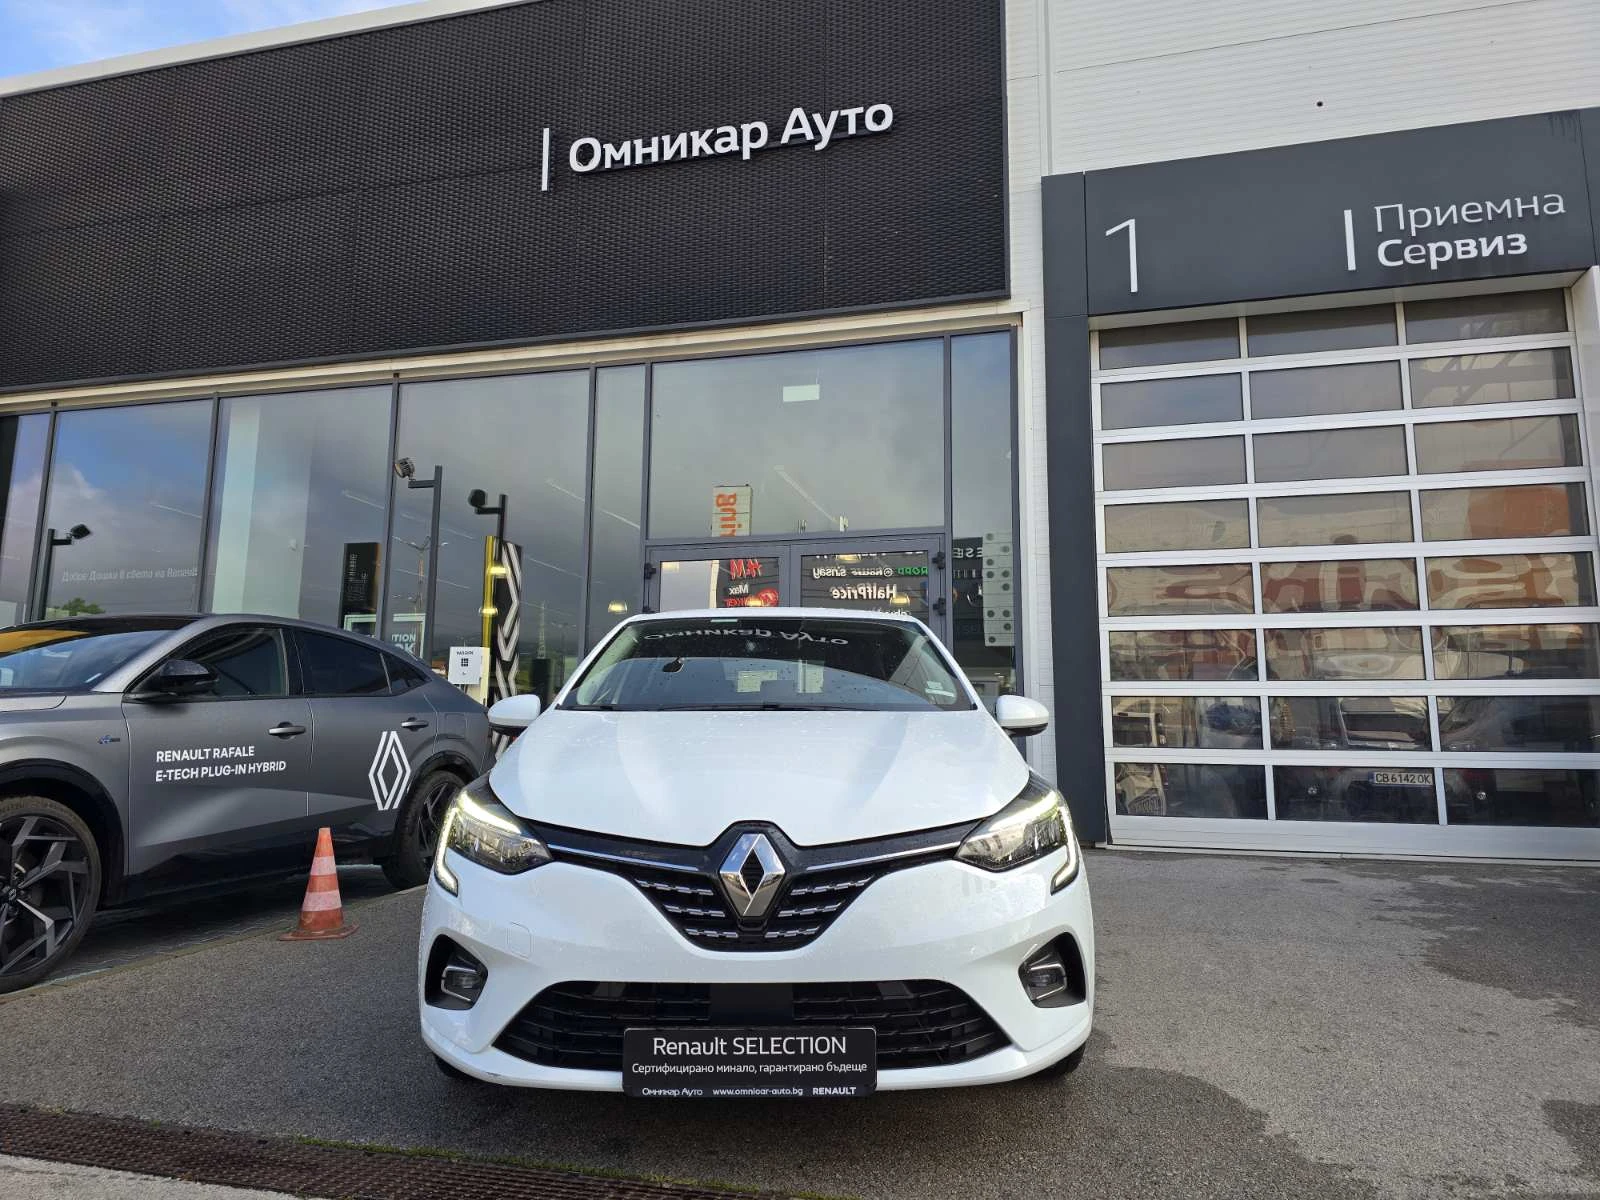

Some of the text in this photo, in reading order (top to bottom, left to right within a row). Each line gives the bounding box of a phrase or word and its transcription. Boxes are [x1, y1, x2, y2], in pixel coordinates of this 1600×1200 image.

[569, 103, 893, 172] Омникар Ауто
[1374, 192, 1565, 237] Приемна
[1105, 218, 1138, 293] 1
[1377, 232, 1528, 270] Сервиз
[156, 745, 255, 762] RENAULT RAFALE
[155, 760, 287, 782] E-TECH PLUG-IN HYBRID
[653, 1036, 846, 1055] Renault SELECTION
[631, 1061, 868, 1075] Сертифицирано минало, гарантирано бъдеще
[812, 1086, 856, 1096] RENAULT
